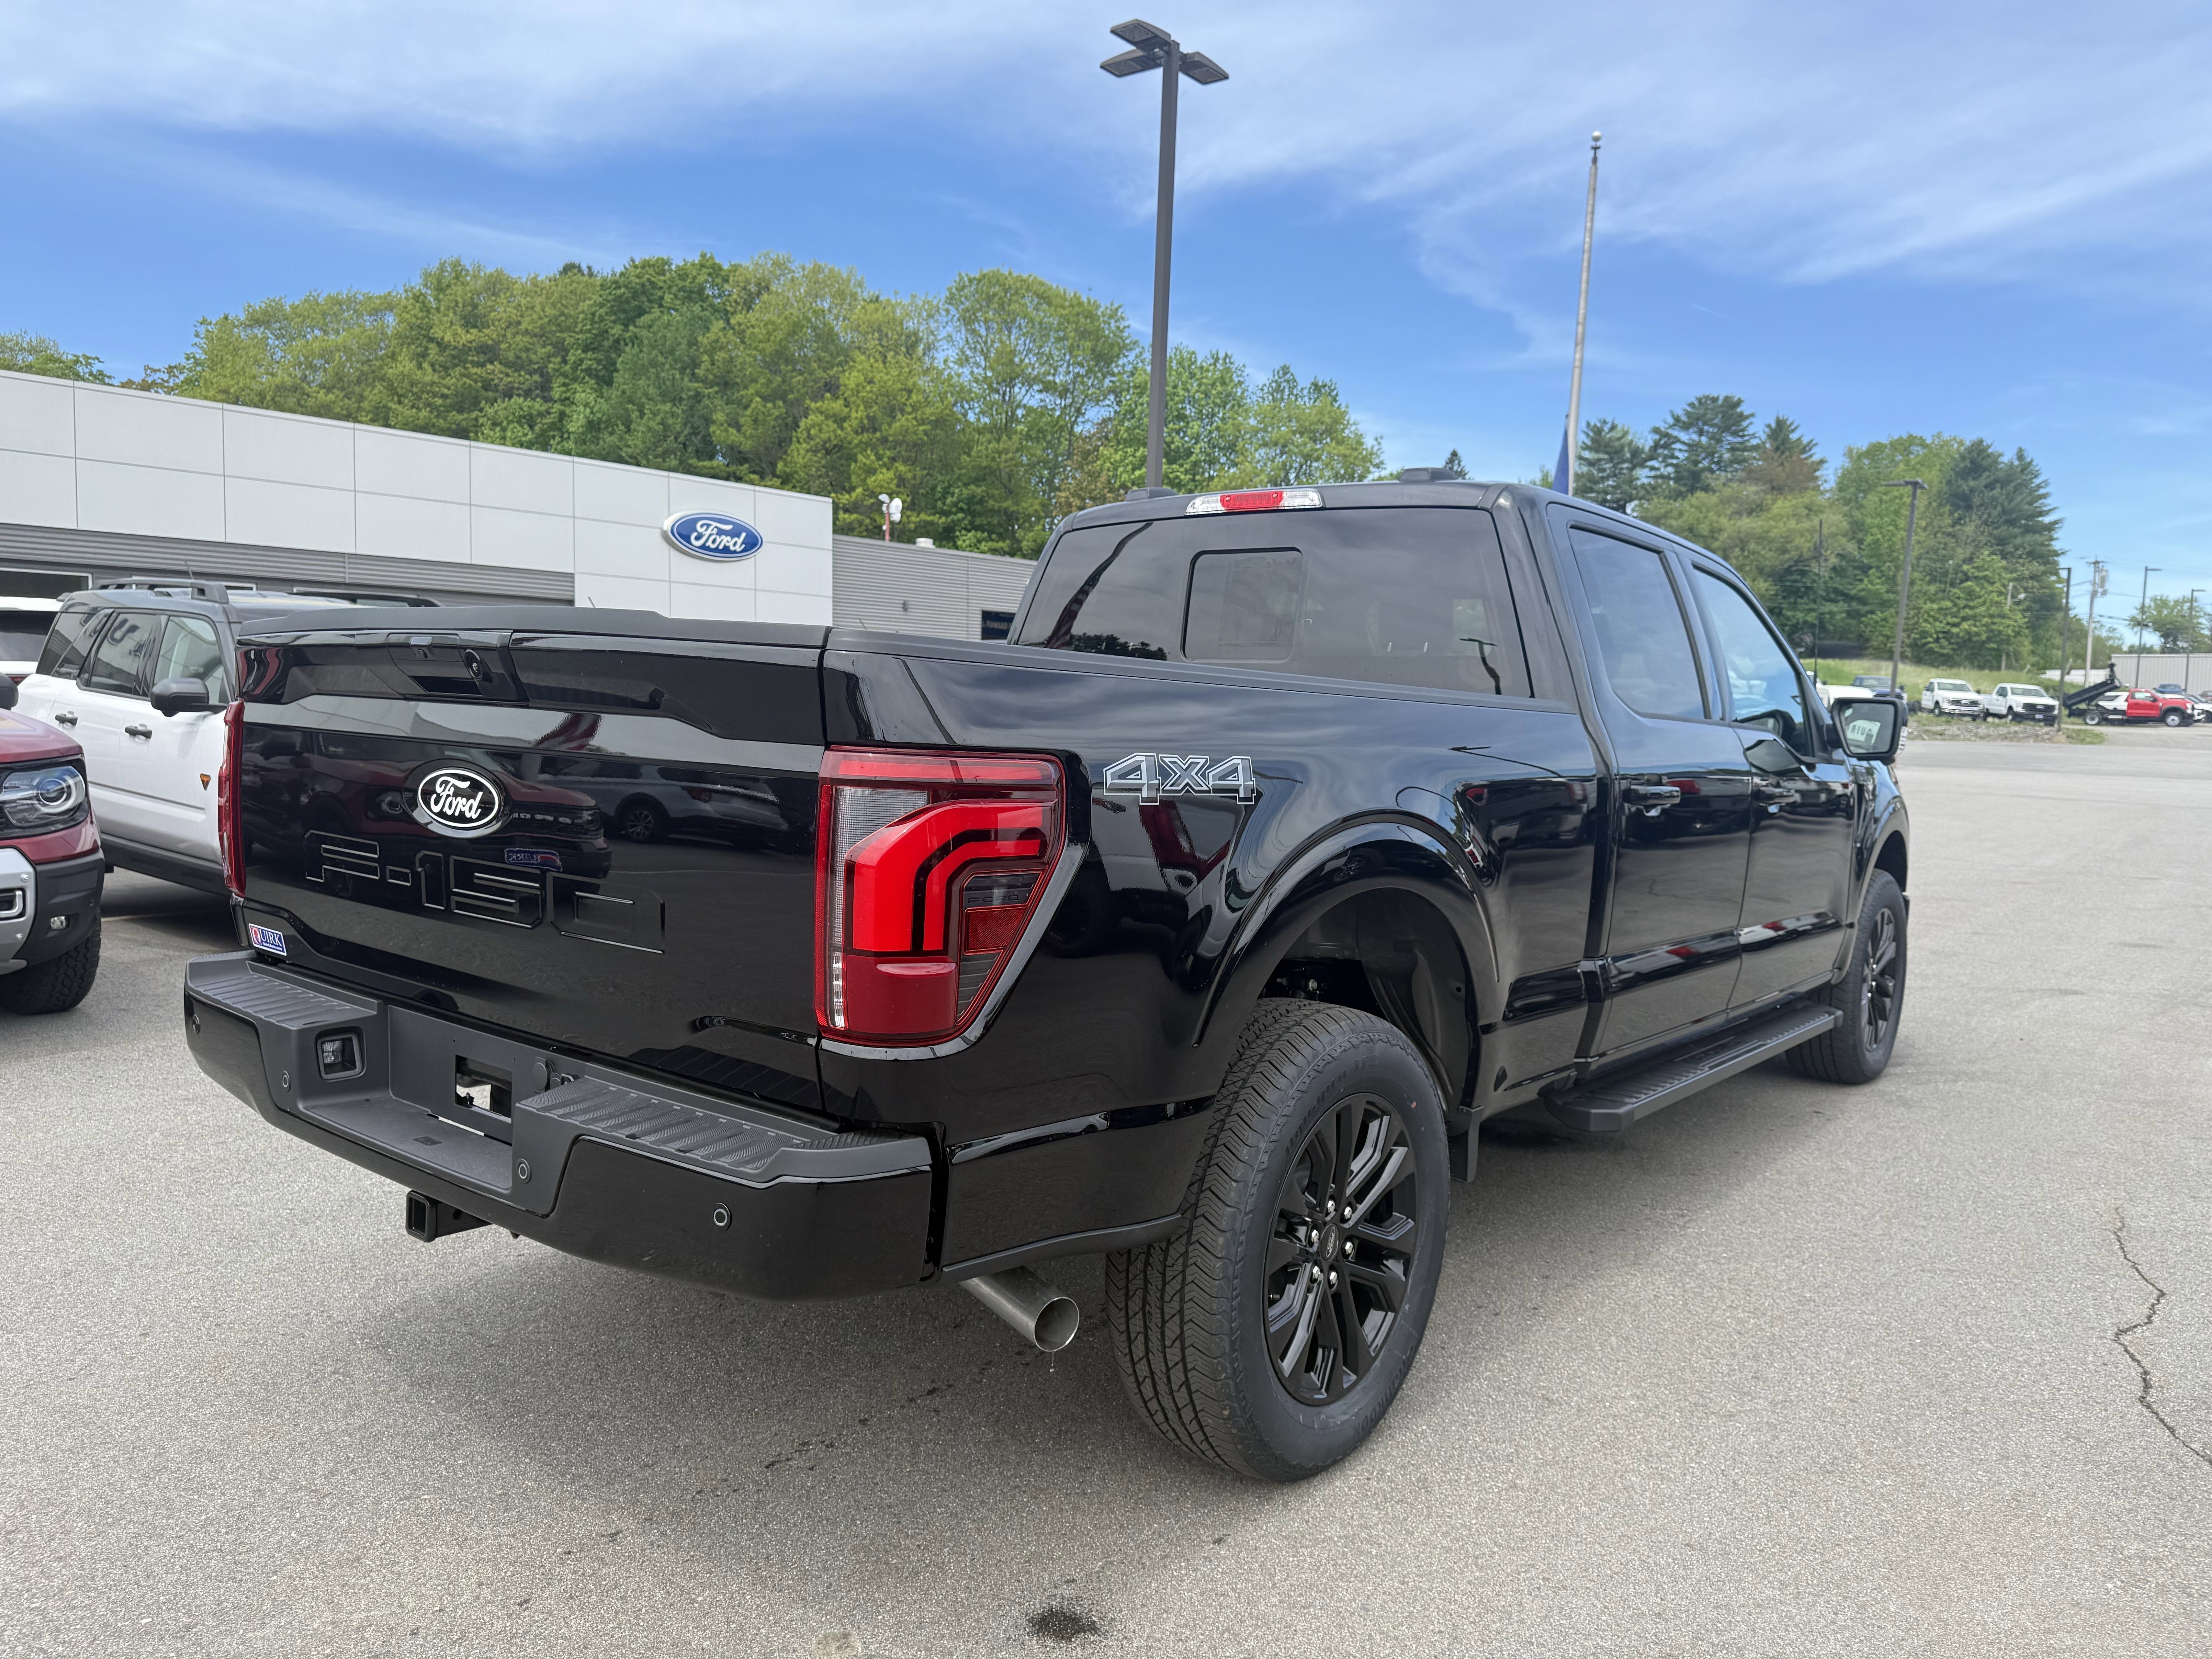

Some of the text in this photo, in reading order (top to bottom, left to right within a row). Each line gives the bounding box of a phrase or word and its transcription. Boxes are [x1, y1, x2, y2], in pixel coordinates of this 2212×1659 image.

[690, 520, 747, 552] Ford
[430, 776, 483, 819] Ford
[305, 830, 665, 954] F-150
[968, 895, 1019, 903] FORD
[252, 927, 283, 947] QUIRK
